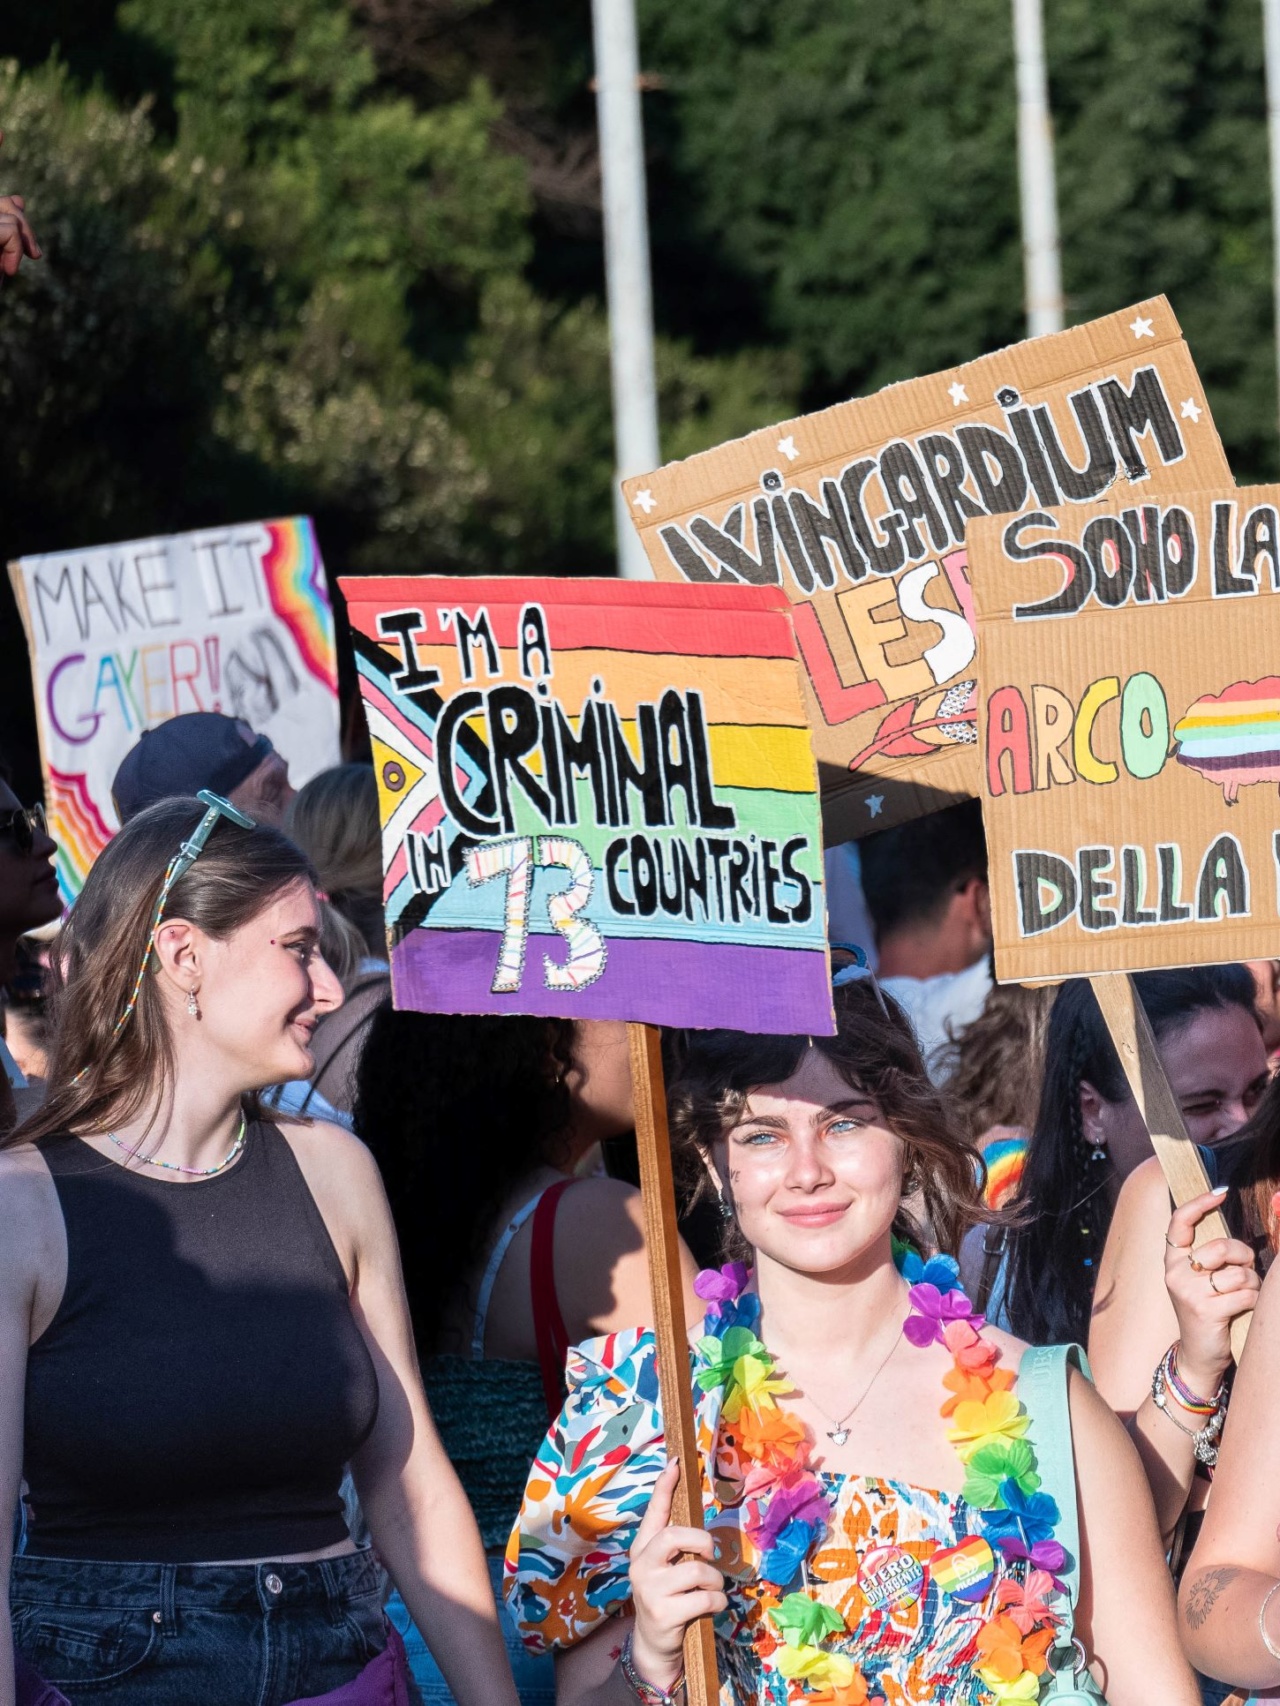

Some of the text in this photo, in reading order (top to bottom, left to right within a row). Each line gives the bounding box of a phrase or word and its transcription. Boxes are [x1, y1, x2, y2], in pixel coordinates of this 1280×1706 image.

[34, 537, 264, 645] MAKE IT
[1003, 505, 1198, 622] SONO
[46, 636, 221, 746] GAYER!
[377, 602, 552, 694] I'M A
[986, 671, 1170, 797] ARCO
[405, 826, 452, 894] IN
[462, 834, 608, 994] 73
[1012, 832, 1251, 937] DELLA
[859, 1553, 915, 1592] ETERO
[866, 1565, 921, 1605] DIVERGENTE
